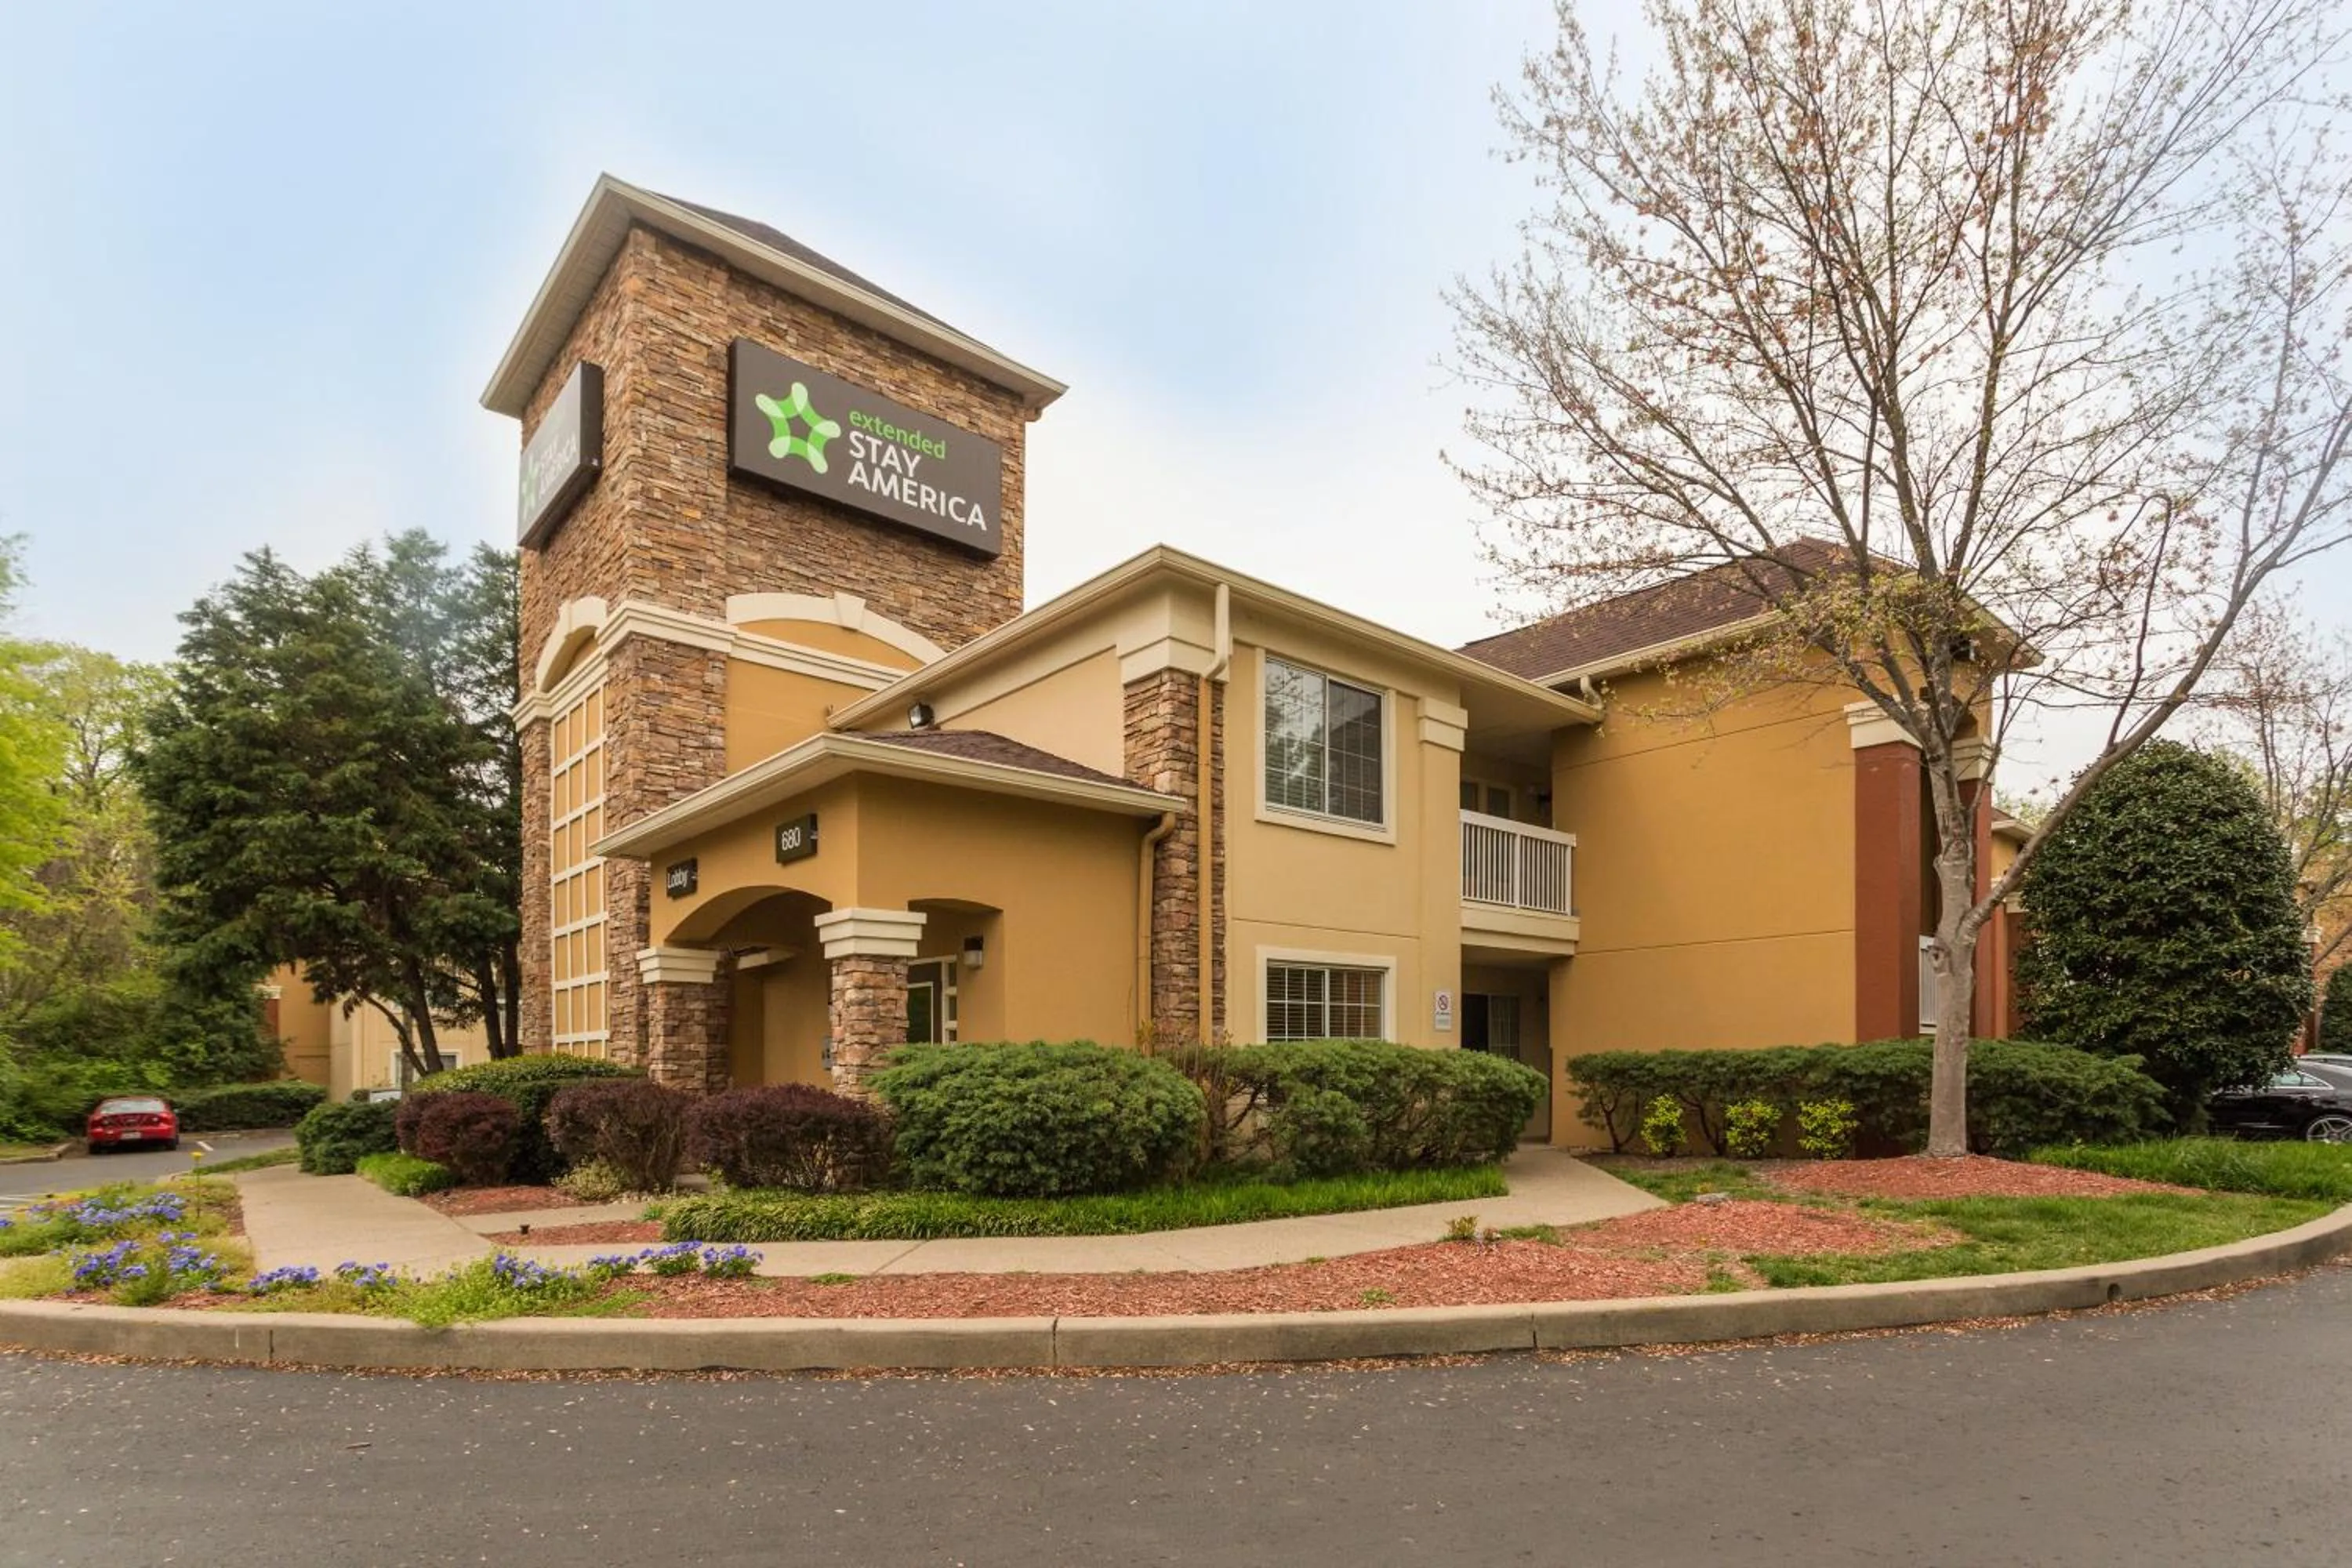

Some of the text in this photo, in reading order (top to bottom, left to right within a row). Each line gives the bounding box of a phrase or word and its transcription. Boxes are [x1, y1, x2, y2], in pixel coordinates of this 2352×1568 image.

[848, 430, 922, 477] STAY
[849, 410, 946, 460] extended
[848, 460, 988, 532] AMERICA
[782, 827, 800, 851] 680
[667, 869, 688, 888] Lobby
